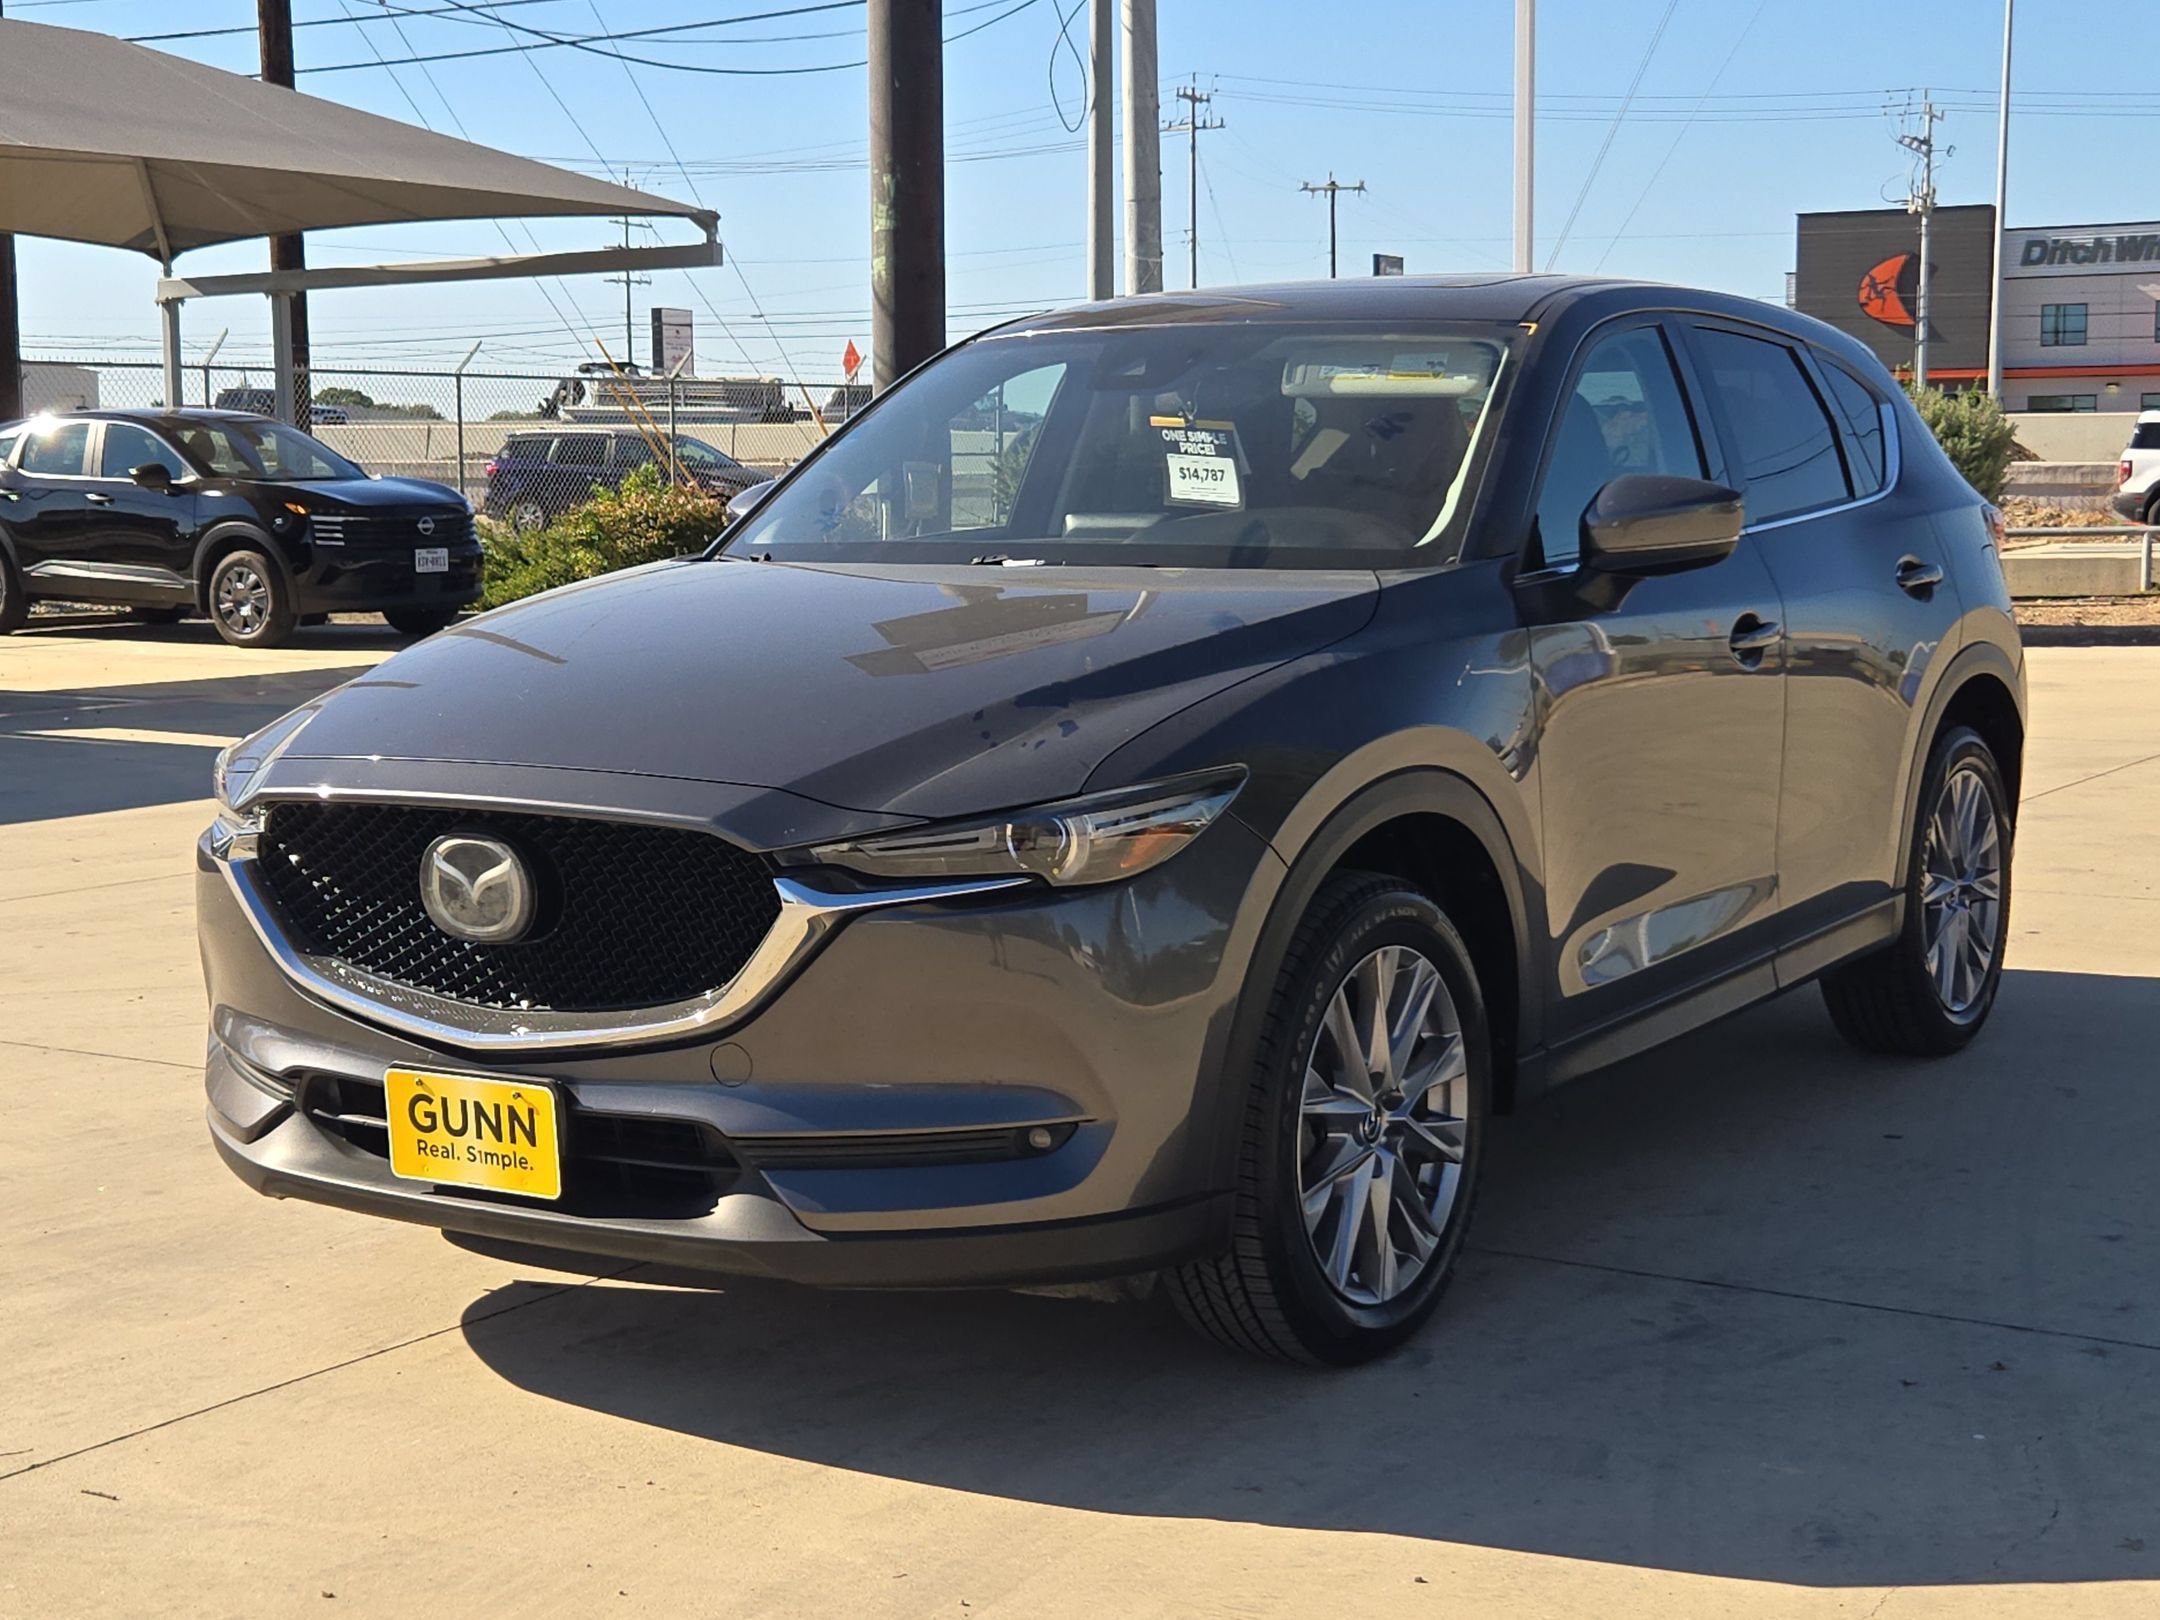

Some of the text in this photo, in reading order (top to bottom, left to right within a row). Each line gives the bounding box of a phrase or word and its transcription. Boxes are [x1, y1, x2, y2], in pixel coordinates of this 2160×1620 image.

[2020, 238, 2113, 266] Ditch
[1161, 429, 1227, 445] ONE SIMPLE
[1179, 467, 1225, 483] $14,787
[408, 1094, 536, 1147] GUNN
[417, 1139, 461, 1161] Real.
